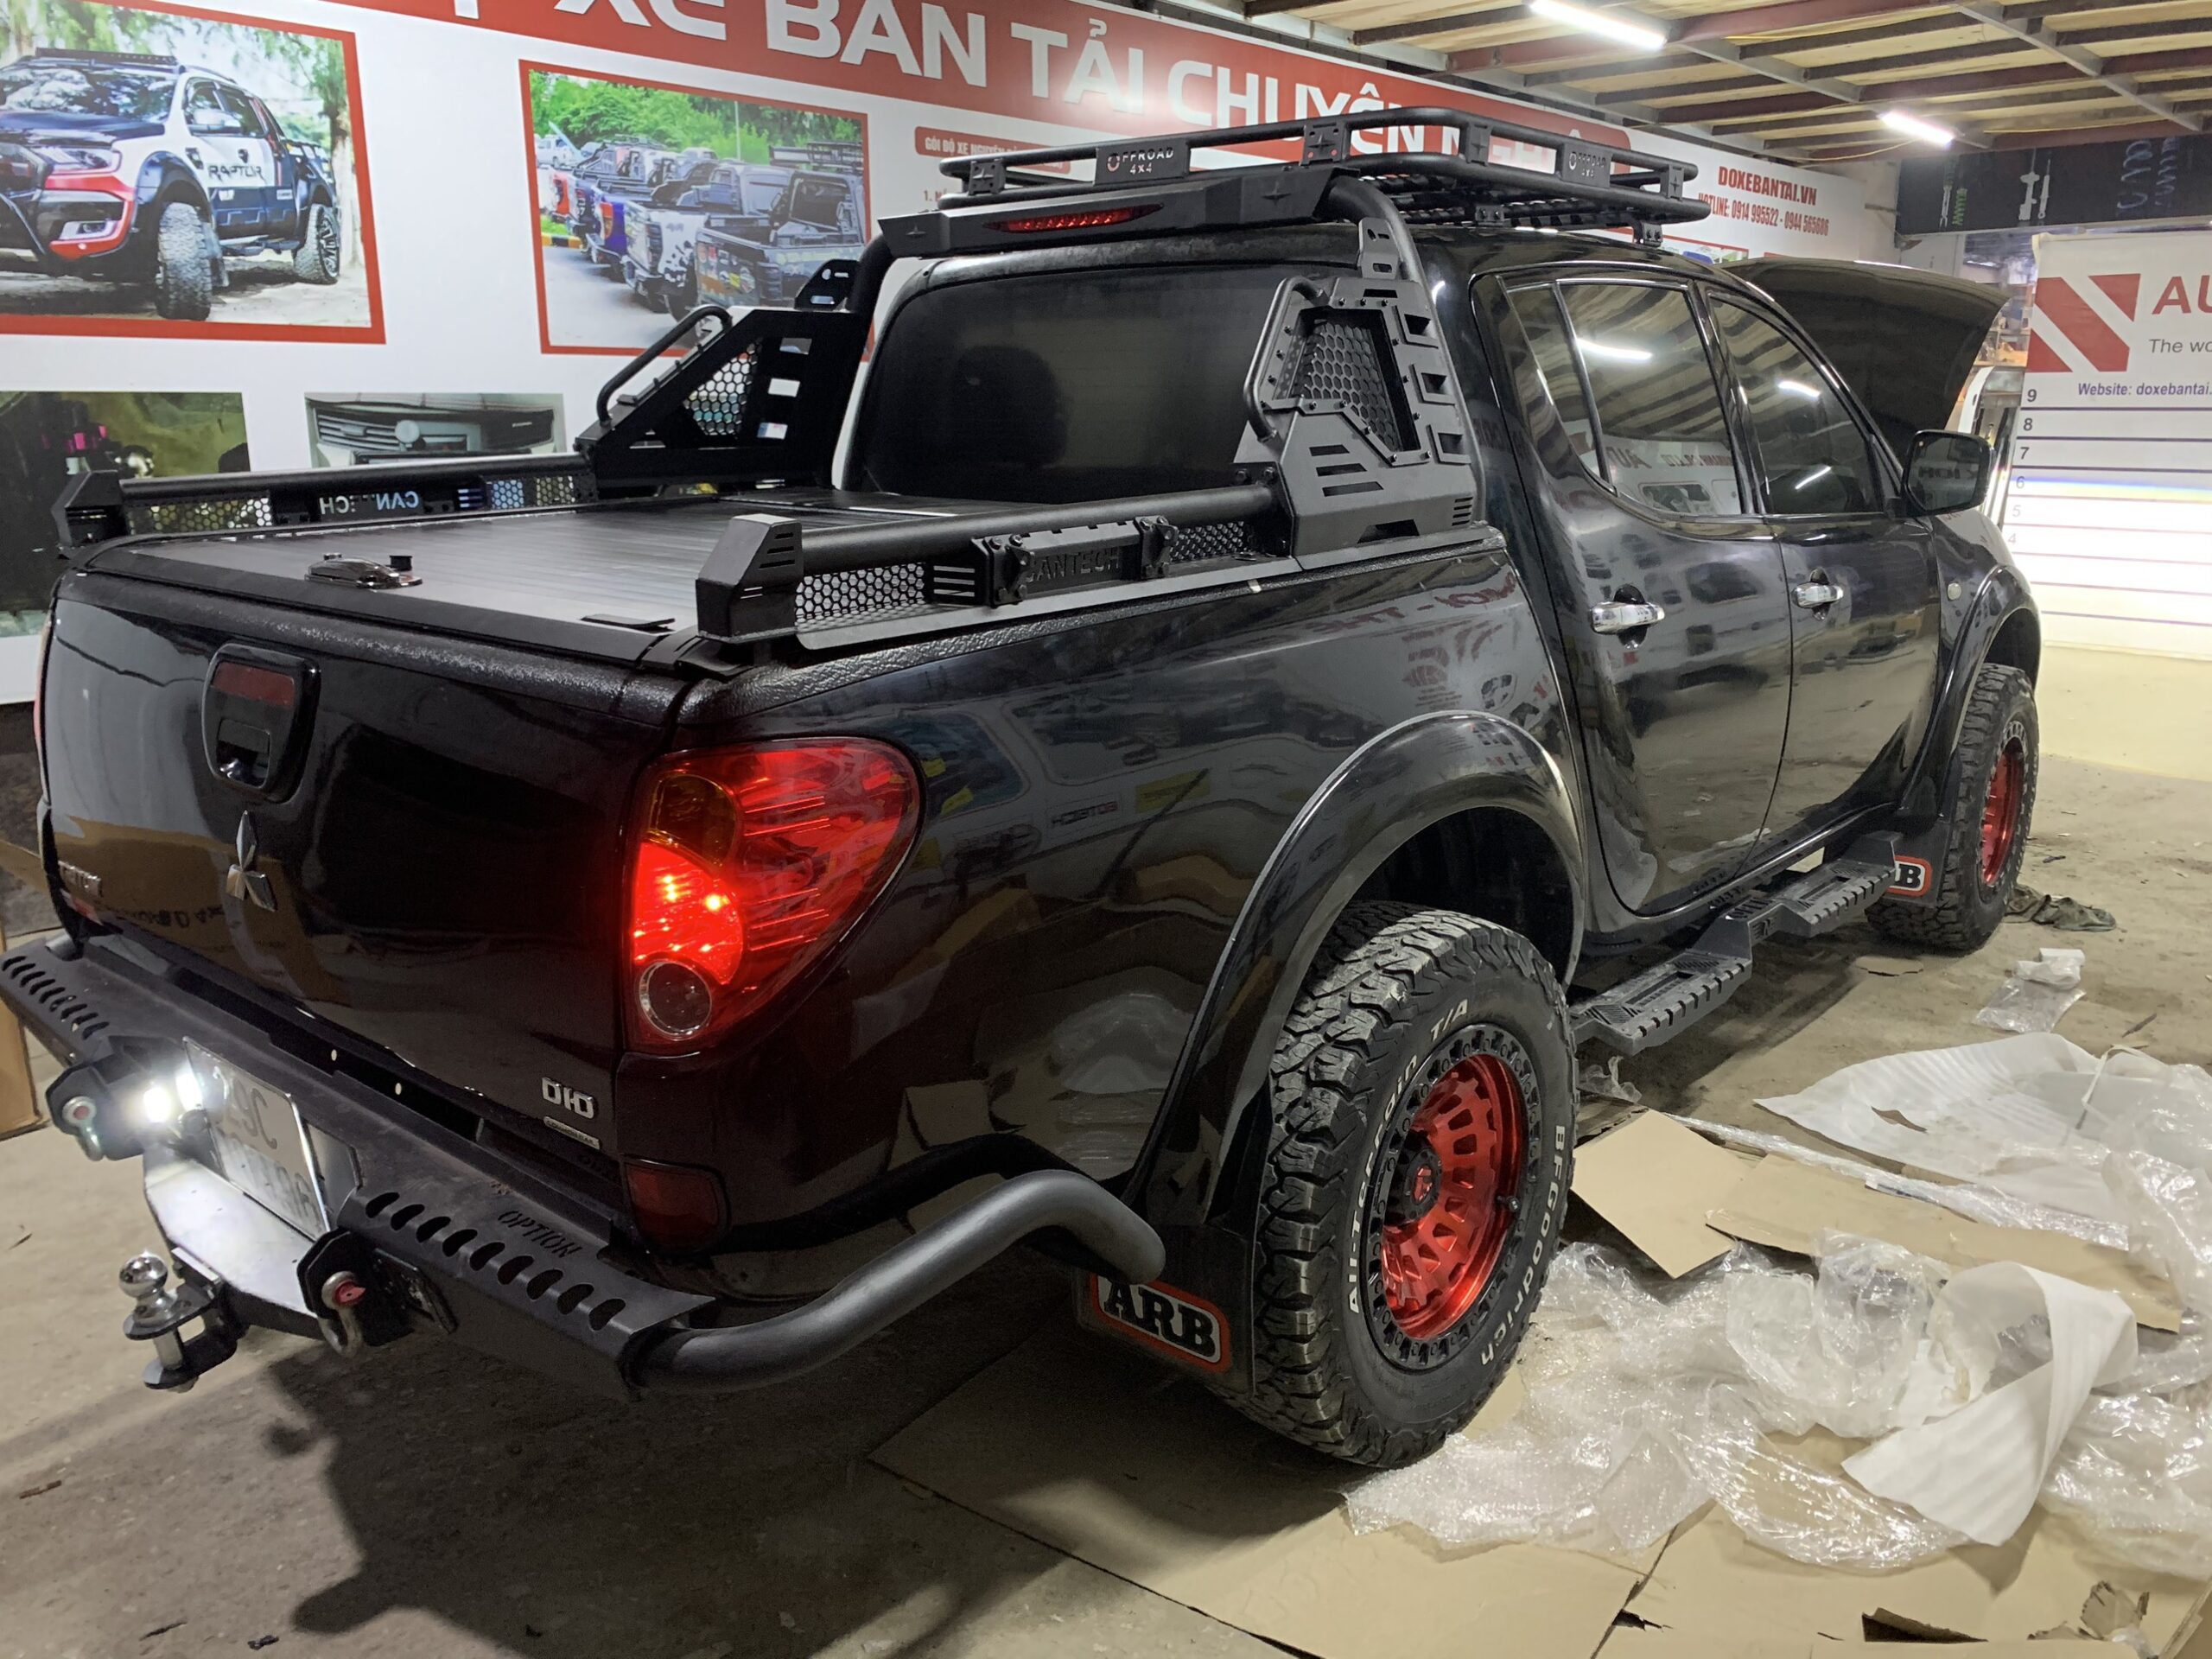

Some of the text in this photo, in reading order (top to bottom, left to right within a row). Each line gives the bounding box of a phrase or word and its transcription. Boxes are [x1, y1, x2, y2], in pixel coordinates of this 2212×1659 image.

[1010, 17, 1145, 116] TẢI
[957, 142, 969, 156] XE
[1107, 146, 1174, 172] OFFROAD
[1718, 166, 1817, 206] DOXEBANTAI.VN
[1732, 200, 1751, 221] 0914
[1751, 204, 1780, 227] 995522
[2148, 338, 2183, 353] The
[2027, 389, 2037, 403] 9
[2077, 382, 2133, 396] Website:
[2023, 417, 2033, 431] 8
[2020, 447, 2030, 460] 7
[2016, 476, 2025, 489] 6
[2012, 505, 2021, 518] 5
[2008, 533, 2017, 544] 4
[1103, 1277, 1217, 1358] ARB
